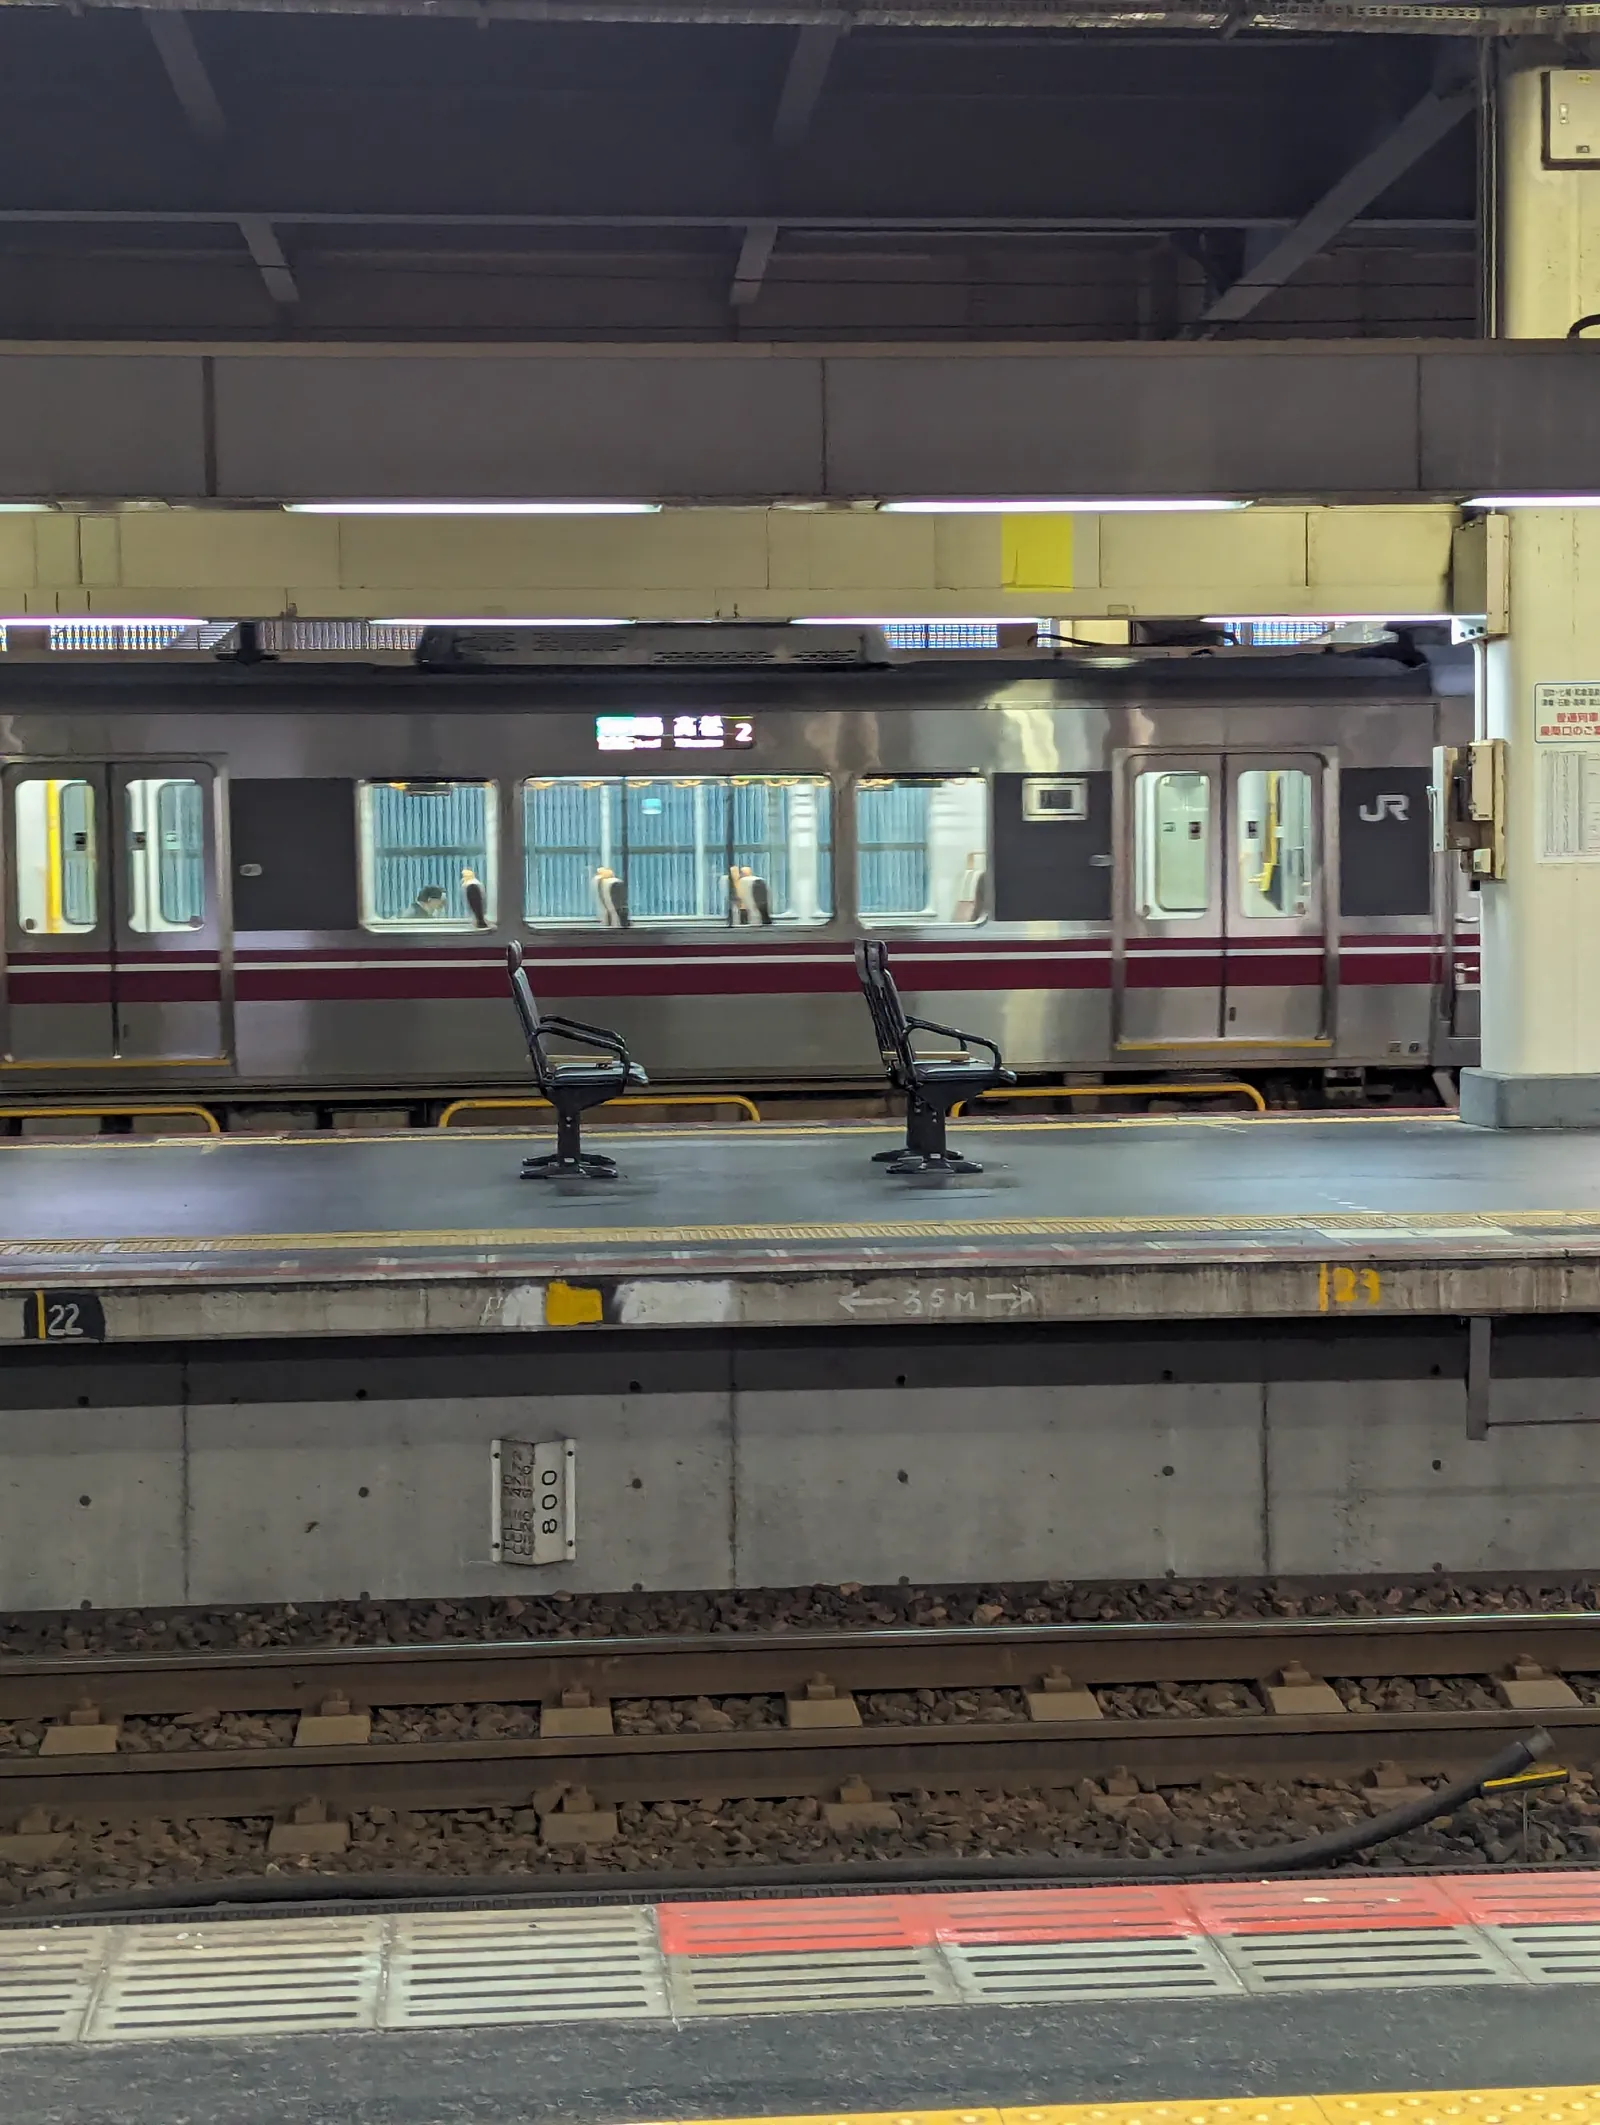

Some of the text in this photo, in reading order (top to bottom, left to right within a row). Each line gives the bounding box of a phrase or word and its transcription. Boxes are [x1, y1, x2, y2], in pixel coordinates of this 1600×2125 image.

[735, 723, 752, 741] 2
[1359, 794, 1409, 821] JR
[48, 1303, 83, 1335] 22
[541, 1470, 557, 1534] 800
